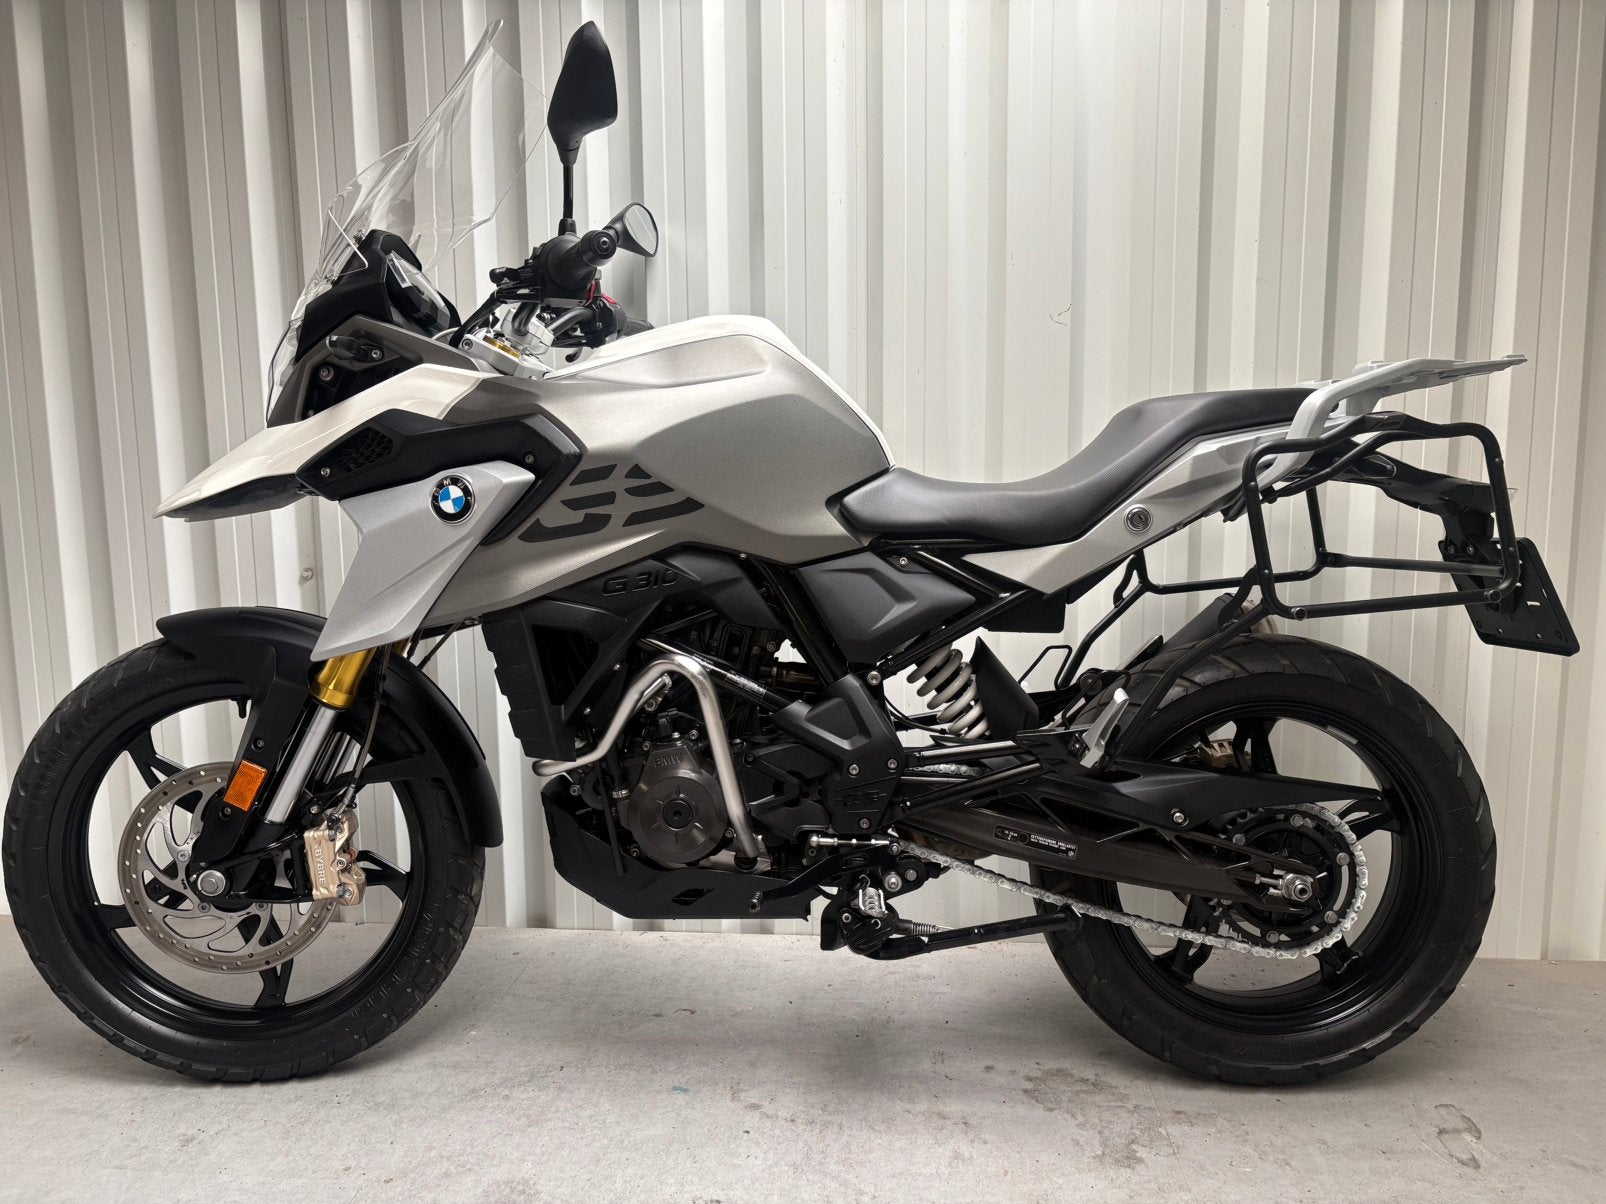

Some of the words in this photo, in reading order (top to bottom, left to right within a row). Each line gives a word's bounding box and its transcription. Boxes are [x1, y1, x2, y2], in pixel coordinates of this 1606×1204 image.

[432, 478, 466, 497] BMW
[602, 575, 629, 597] G
[632, 568, 680, 592] 310
[653, 752, 681, 768] BMW
[314, 848, 327, 885] BYBRE
